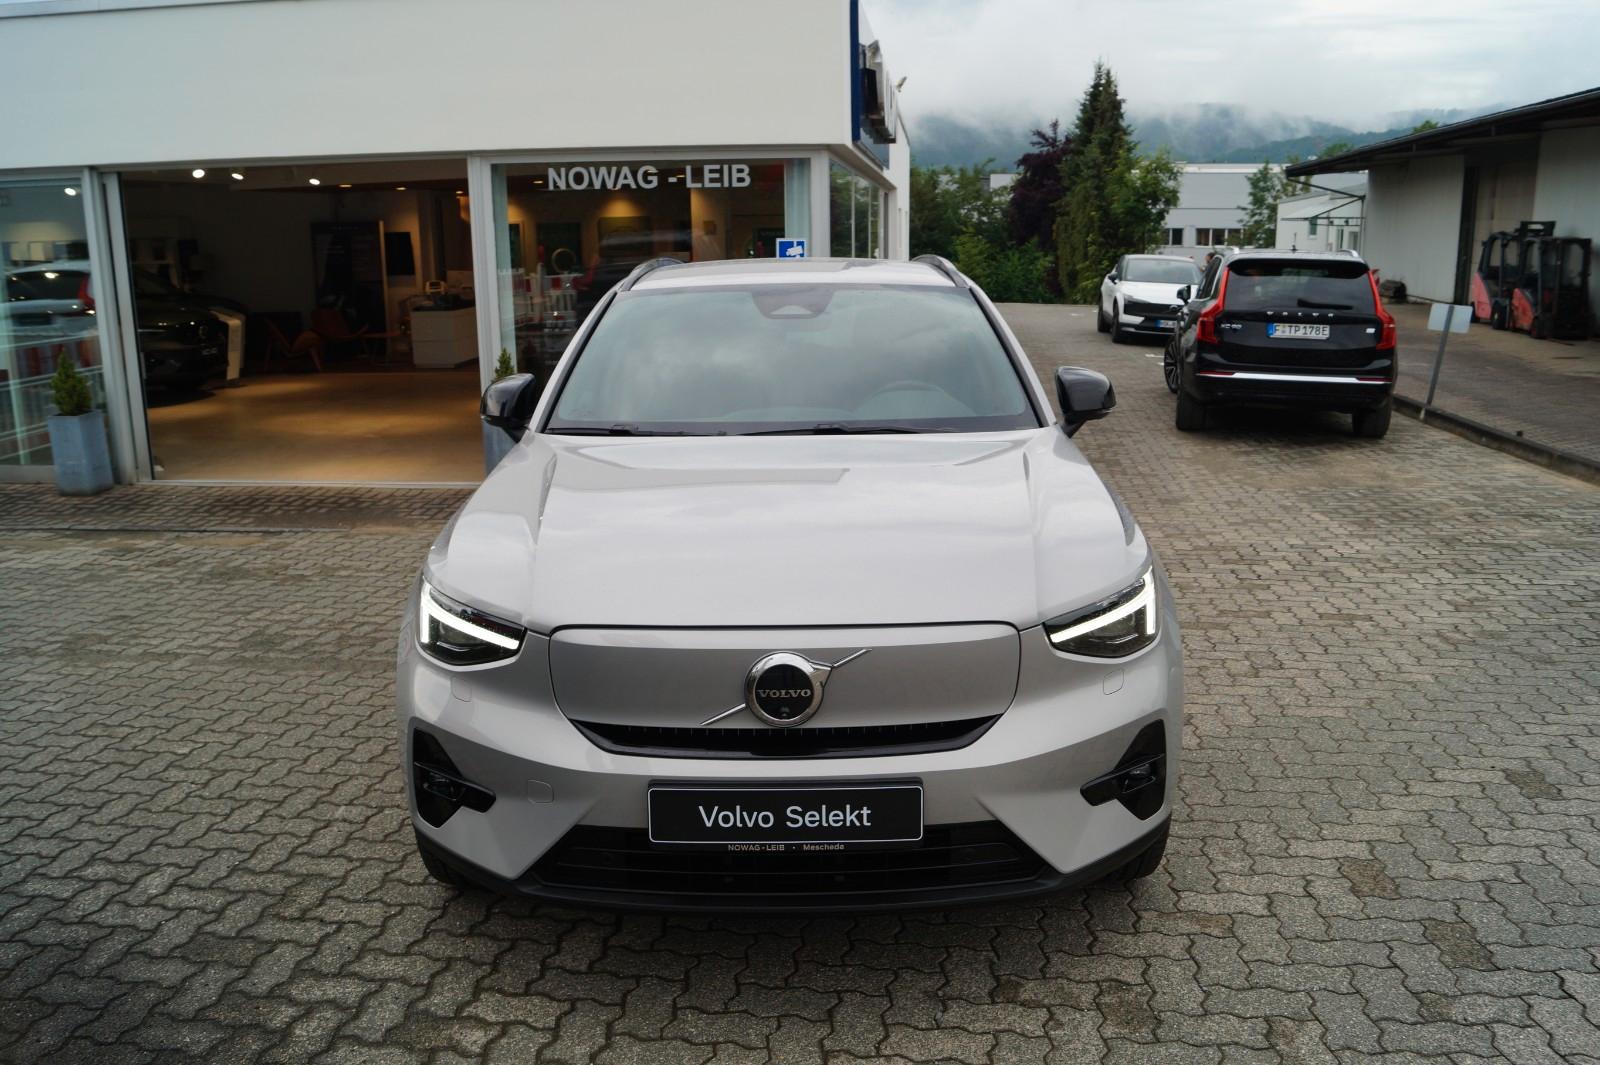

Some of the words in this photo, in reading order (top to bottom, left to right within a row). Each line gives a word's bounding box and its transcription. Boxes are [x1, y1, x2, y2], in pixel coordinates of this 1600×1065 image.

[548, 165, 658, 190] NOWAG
[686, 164, 750, 188] LEIB
[757, 689, 811, 698] VOLVO
[699, 805, 774, 828] Volvo
[785, 804, 872, 827] Selekt
